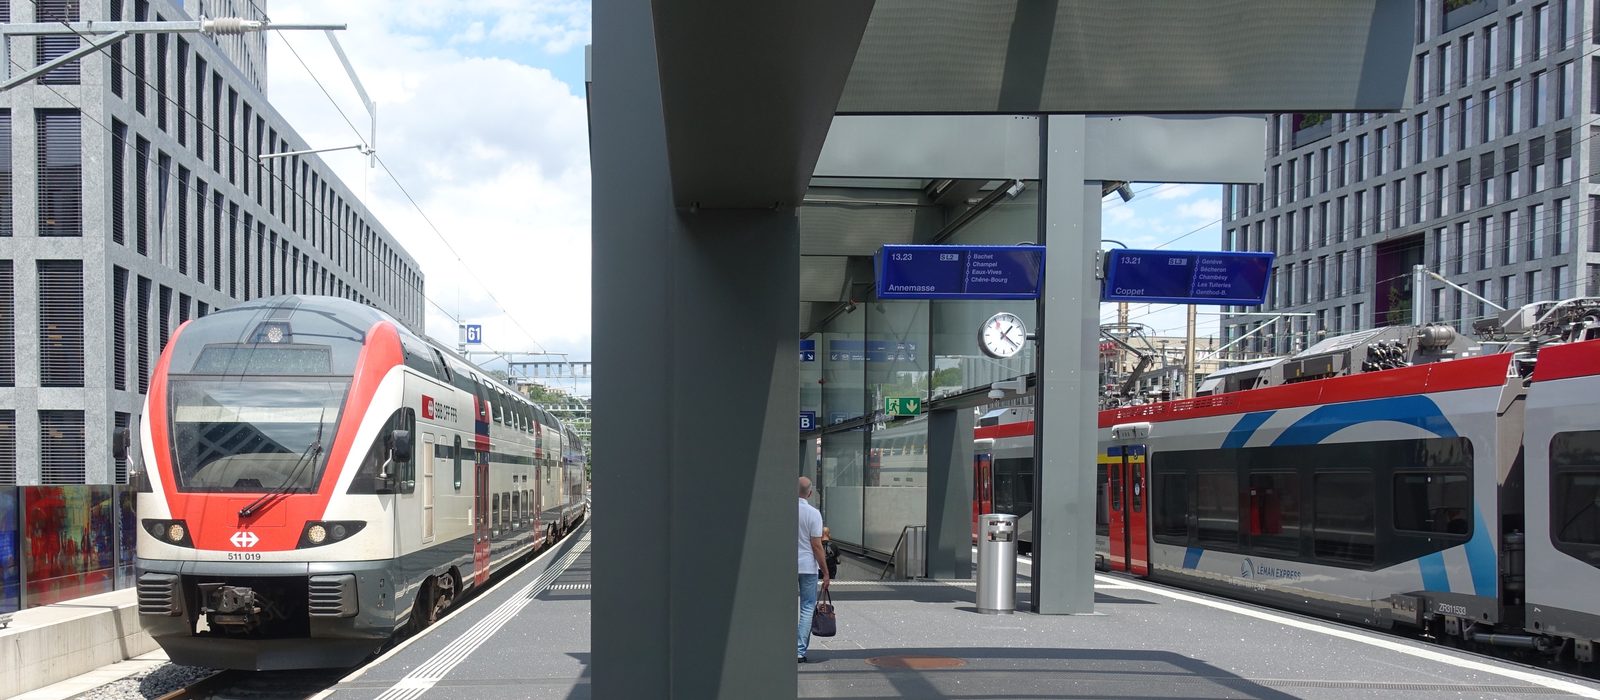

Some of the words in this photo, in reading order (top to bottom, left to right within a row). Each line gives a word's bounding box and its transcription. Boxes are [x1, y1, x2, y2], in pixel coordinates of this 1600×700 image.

[891, 253, 913, 261] 13.23
[1120, 256, 1141, 264] 13.21
[888, 284, 935, 292] Annemasse
[1115, 287, 1144, 296] Coppet
[468, 327, 480, 341] 61
[801, 418, 810, 428] B
[1276, 568, 1302, 580] EXPRESS
[1438, 602, 1466, 616] ZR311533
